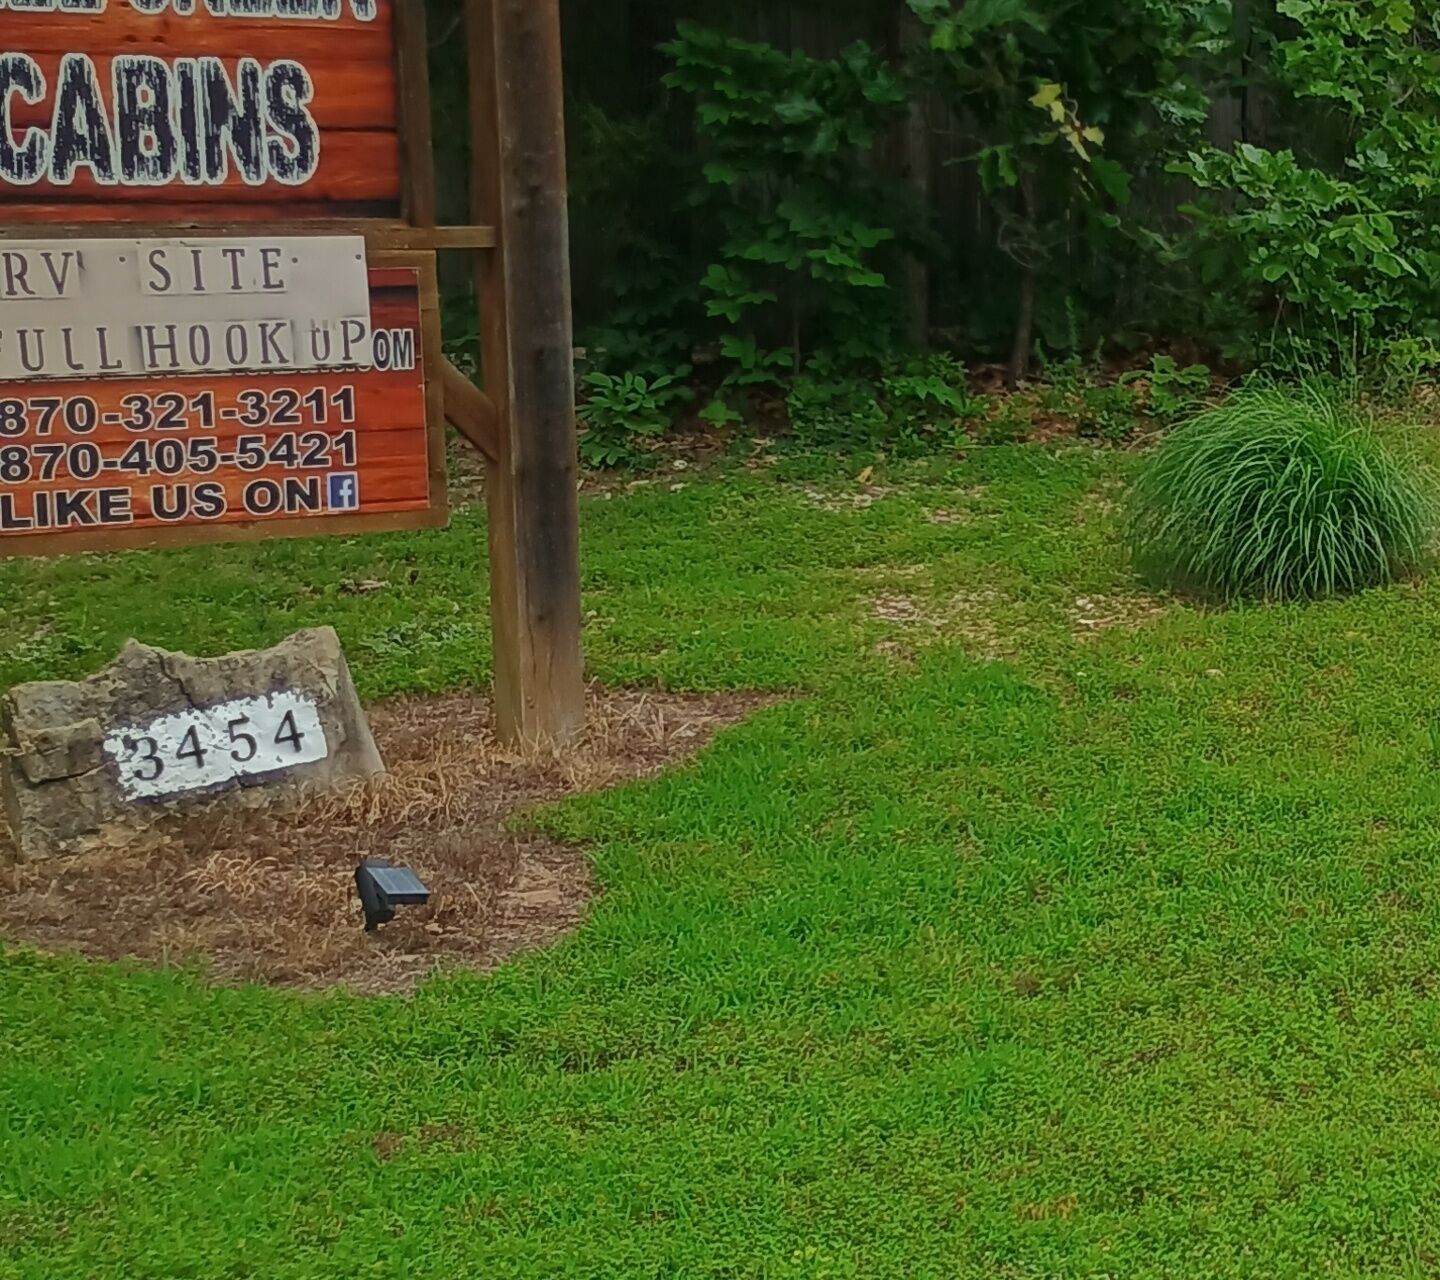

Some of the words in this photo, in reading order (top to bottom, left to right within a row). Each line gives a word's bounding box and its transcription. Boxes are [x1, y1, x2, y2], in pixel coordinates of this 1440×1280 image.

[0, 52, 320, 186] CABINS
[2, 252, 75, 295] RV
[148, 248, 285, 292] SITE
[0, 326, 123, 372] ULL
[0, 386, 355, 437] 870-321-3211
[0, 430, 357, 483] 870-405-5421
[0, 487, 134, 532] LIKE
[151, 481, 227, 522] US
[243, 476, 321, 517] ON
[129, 709, 305, 781] 3454
